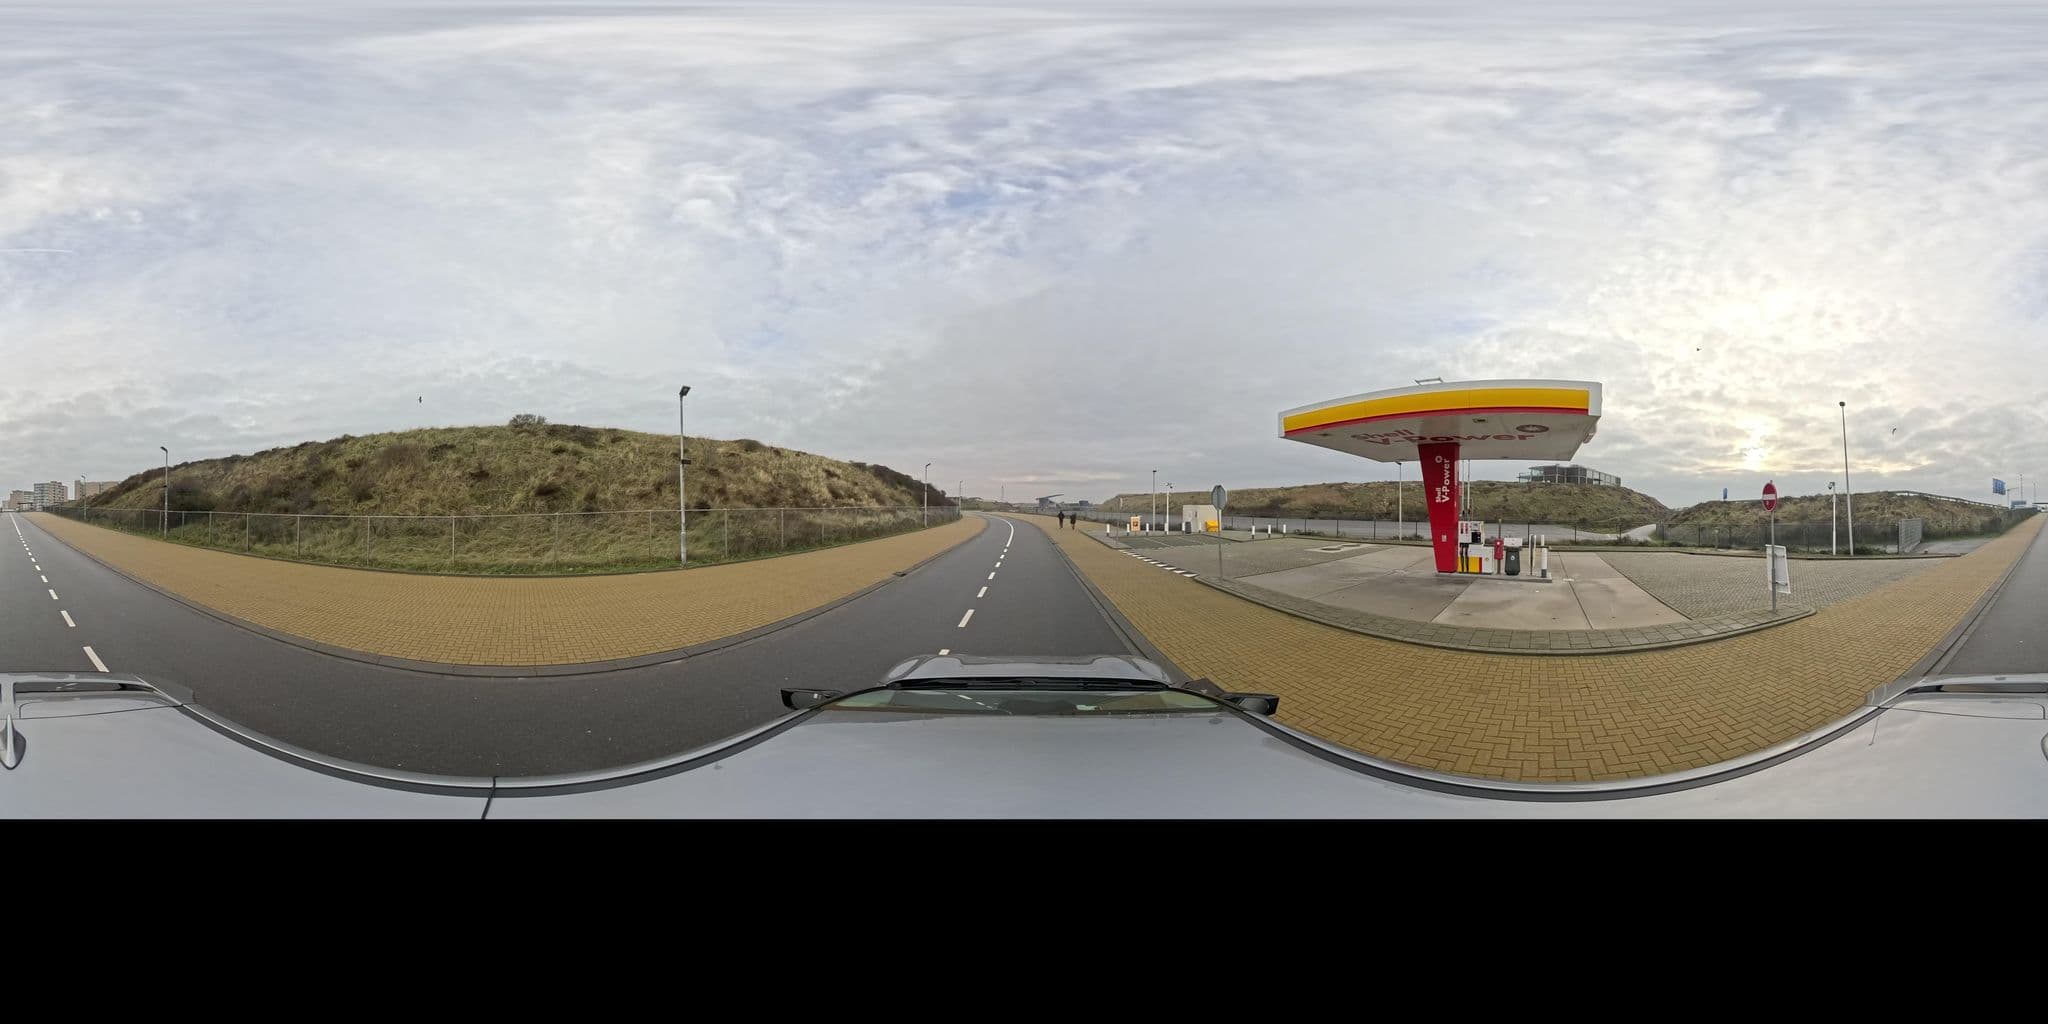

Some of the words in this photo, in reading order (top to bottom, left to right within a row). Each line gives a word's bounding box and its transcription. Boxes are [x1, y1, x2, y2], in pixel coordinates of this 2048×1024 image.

[1351, 429, 1414, 439] Shell
[1365, 434, 1536, 445] V-Power
[1441, 458, 1450, 502] V-Power
